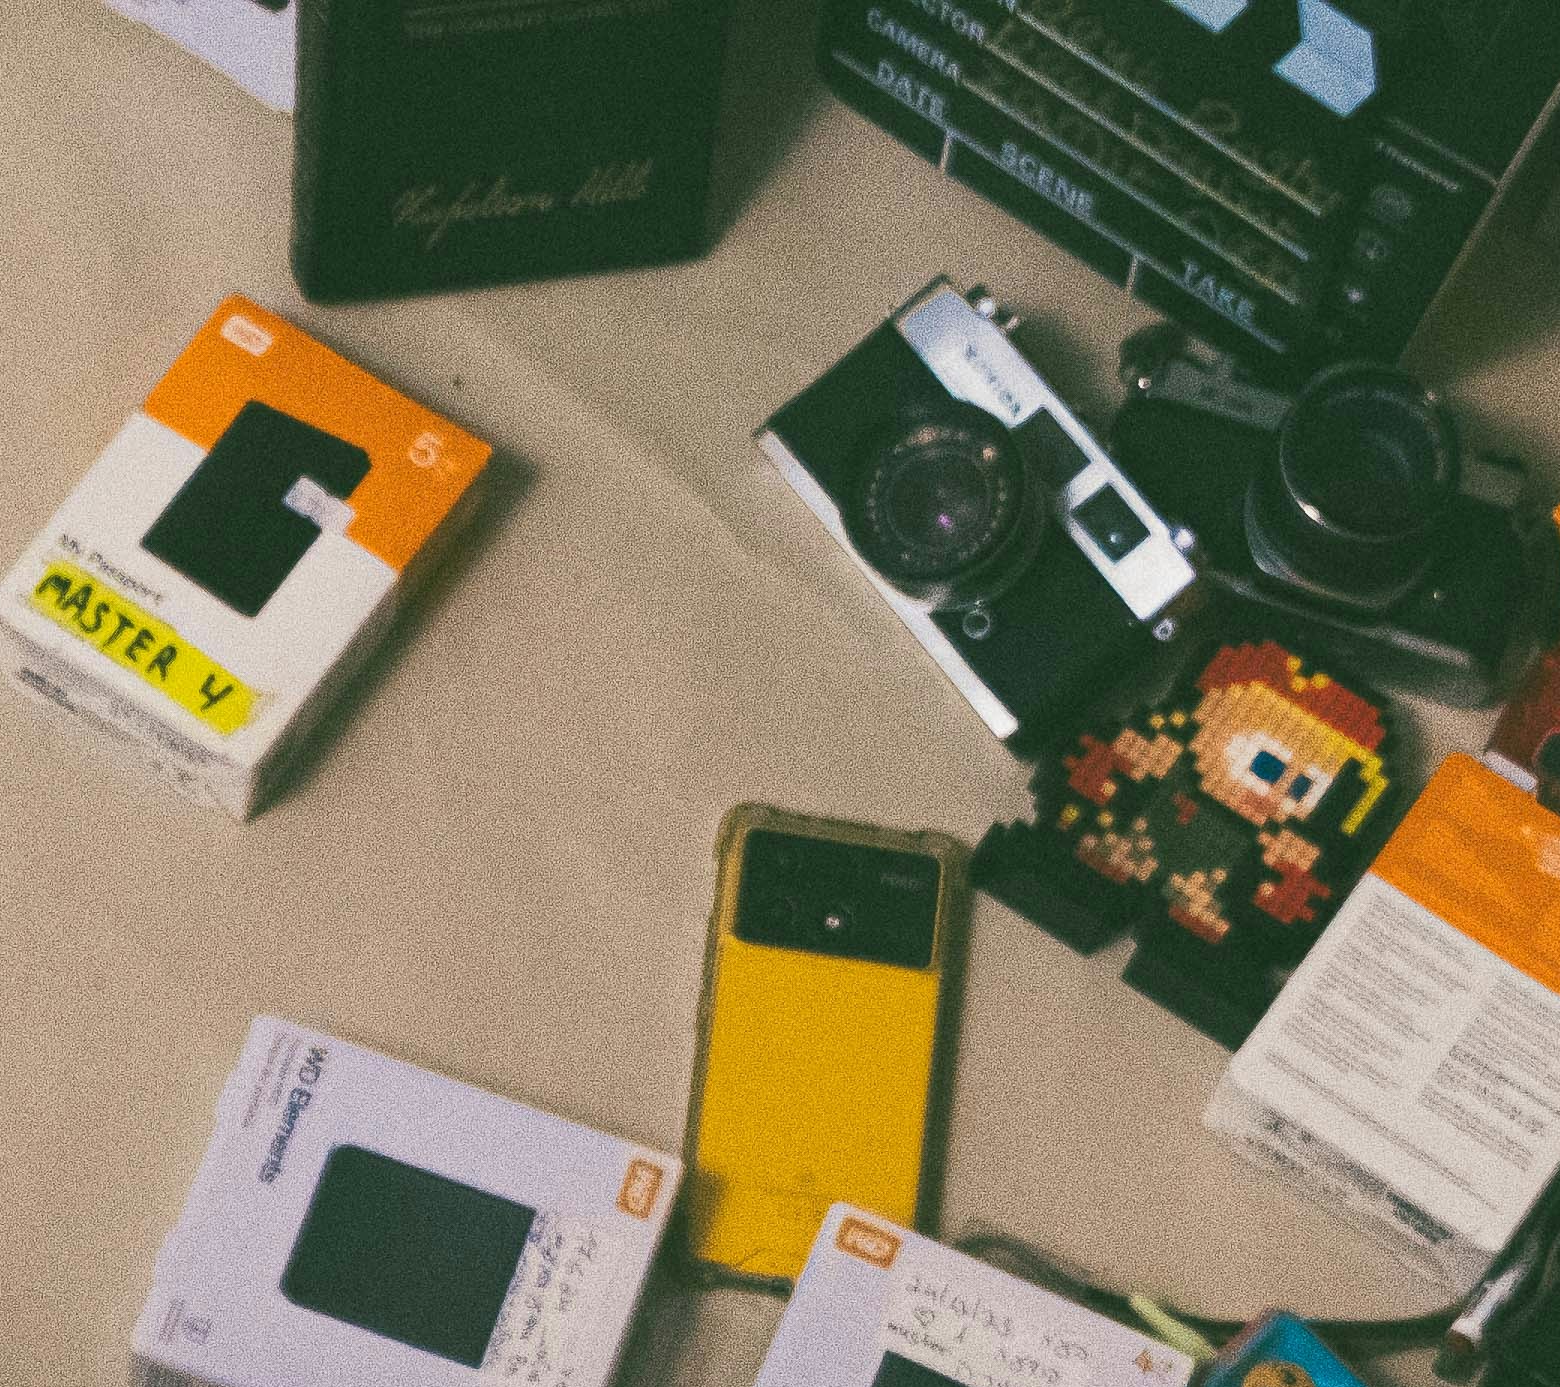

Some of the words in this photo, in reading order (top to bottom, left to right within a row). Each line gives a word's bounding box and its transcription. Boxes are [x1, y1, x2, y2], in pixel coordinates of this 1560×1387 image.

[861, 4, 967, 83] CAMERA
[868, 57, 952, 122] DATE
[993, 139, 1101, 220] SCENE
[1174, 258, 1260, 324] TAKE
[27, 561, 188, 681] MASTER
[191, 670, 236, 718] 4
[295, 1044, 327, 1086] WD
[256, 1085, 312, 1187] Elements
